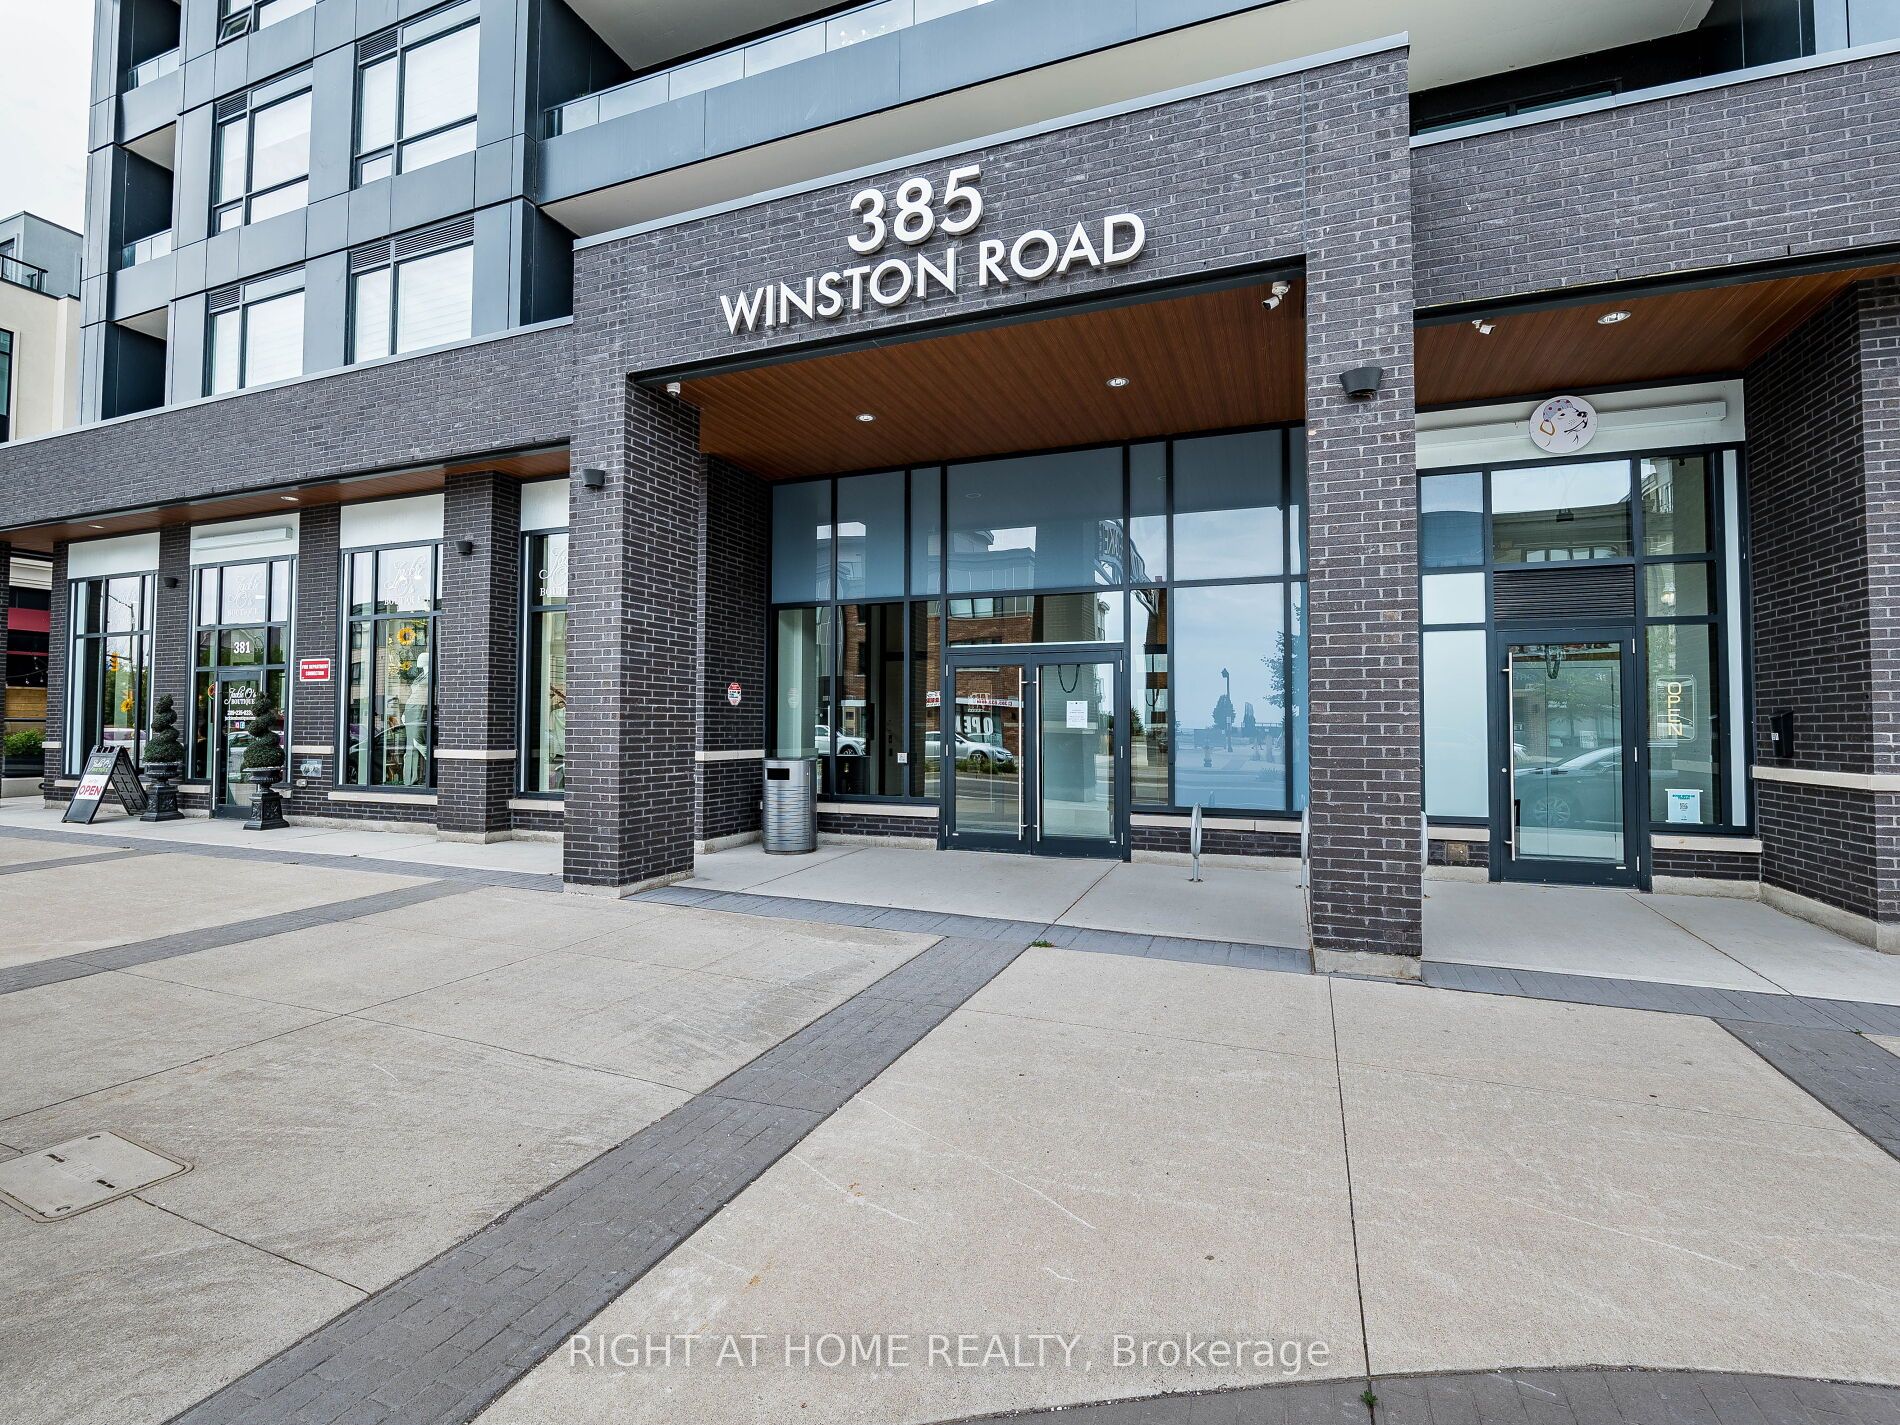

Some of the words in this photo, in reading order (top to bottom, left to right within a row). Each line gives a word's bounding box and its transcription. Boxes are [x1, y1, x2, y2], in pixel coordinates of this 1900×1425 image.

[847, 164, 985, 256] 385
[719, 247, 958, 335] WINSTON
[978, 213, 1145, 288] ROAD
[233, 641, 251, 654] 381
[1667, 681, 1683, 736] OPEN
[79, 785, 103, 796] OPEN
